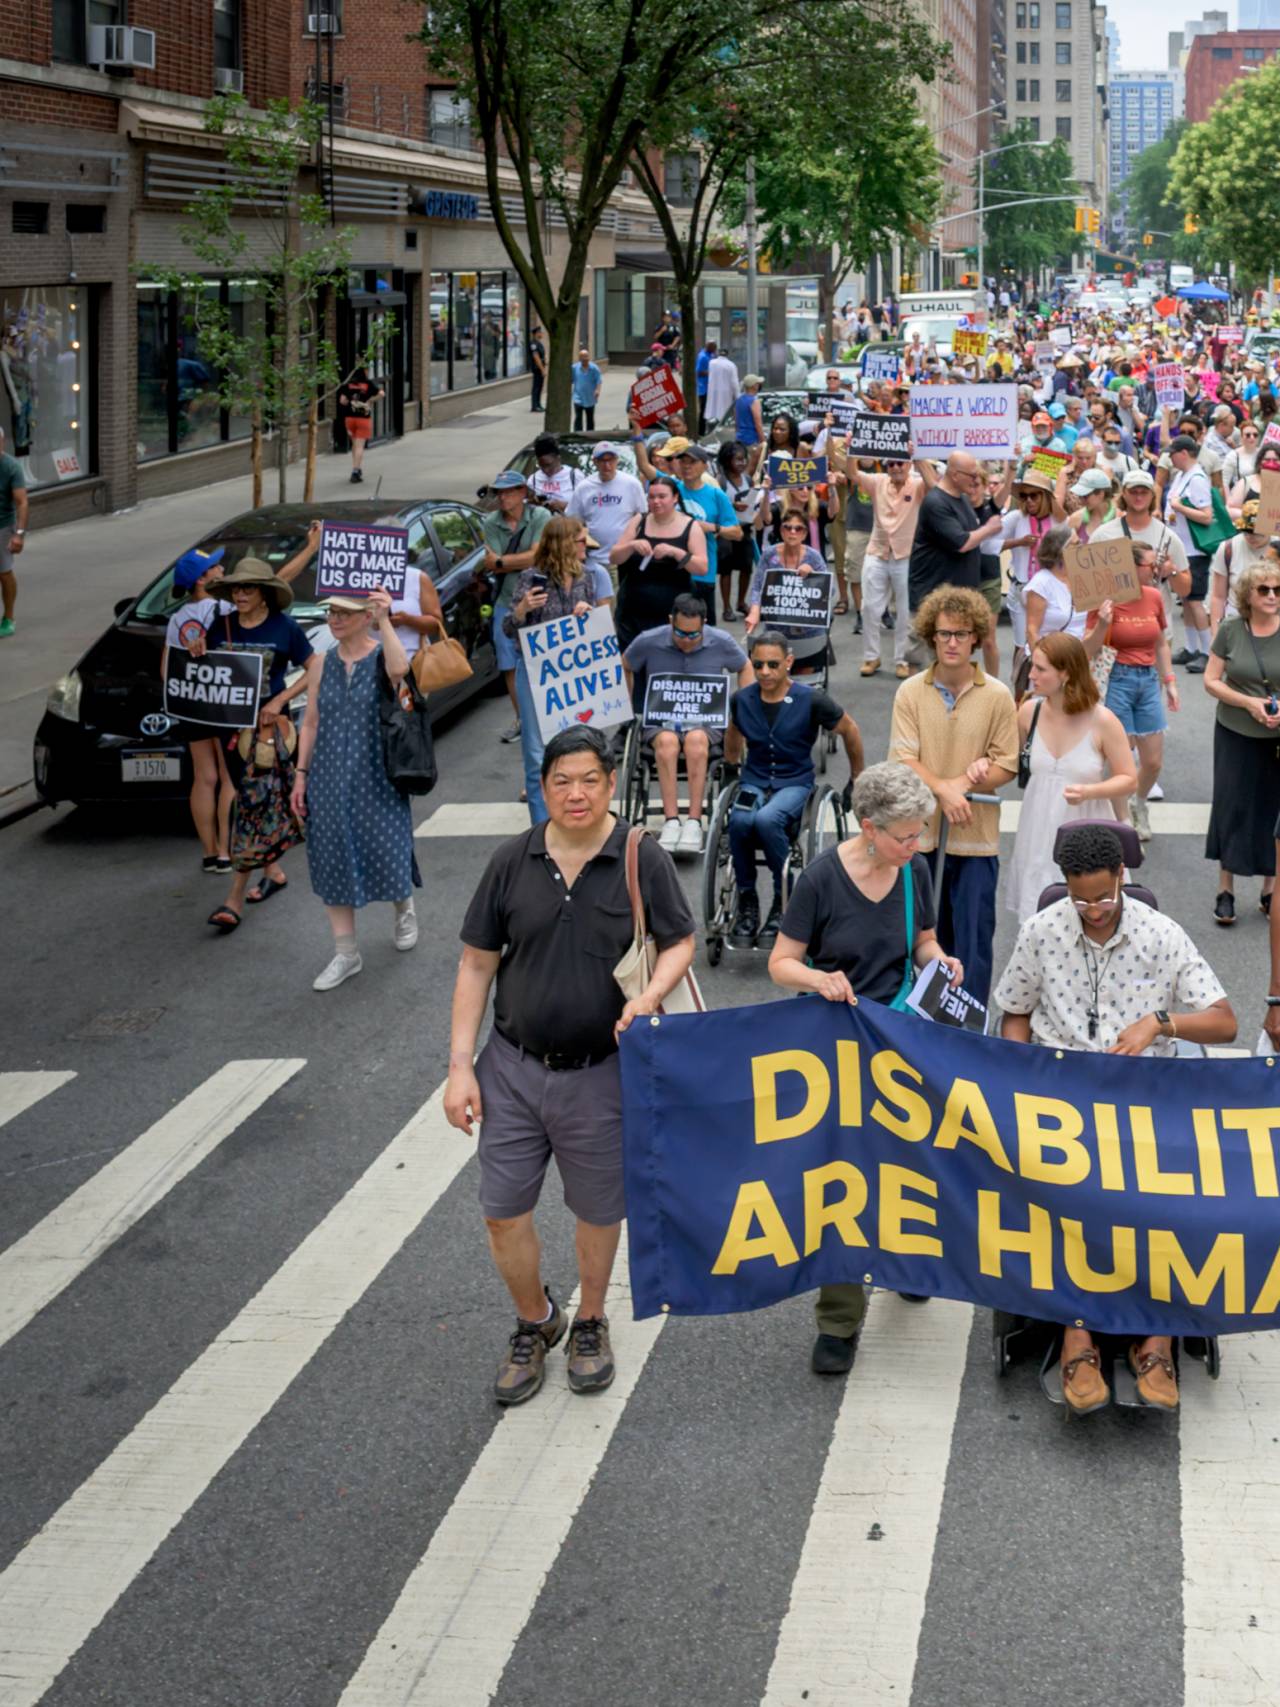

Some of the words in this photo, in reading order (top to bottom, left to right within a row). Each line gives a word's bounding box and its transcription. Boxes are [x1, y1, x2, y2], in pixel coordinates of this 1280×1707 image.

[911, 303, 964, 312] U-HAUL
[1156, 364, 1182, 378] HANDS
[911, 397, 953, 415] IMAGINE
[956, 397, 963, 415] A
[968, 397, 1008, 415] WORLD
[856, 419, 879, 430] THE
[882, 421, 908, 432] ADA
[860, 430, 873, 439] IS
[875, 431, 901, 441] NOT
[916, 428, 960, 444] WITHOUT
[963, 428, 1009, 444] BARRIERS
[851, 439, 908, 452] OPTIONAL
[57, 456, 79, 474] SALE
[778, 460, 817, 473] ADA
[787, 472, 810, 484] 35
[324, 531, 366, 550] HATE
[369, 535, 406, 554] WILL
[323, 550, 358, 568] NOT
[361, 553, 405, 573] MAKE
[321, 569, 345, 587] US
[348, 571, 403, 591] GREAT
[782, 575, 803, 587] WE
[767, 585, 821, 599] DEMAND
[774, 597, 810, 608] 100%
[761, 606, 827, 618] ACCESSIBILITY
[526, 612, 590, 657] KEEP
[539, 634, 620, 686] ACCESS
[185, 662, 232, 685] FOR
[168, 678, 254, 706] SHAME!
[652, 680, 723, 693] DISABILITY
[663, 691, 712, 703] RIGHTS
[673, 702, 700, 713] ARE
[648, 711, 686, 721] HUMAN
[687, 713, 724, 722] RIGHTS
[710, 1160, 943, 1275] ARE
